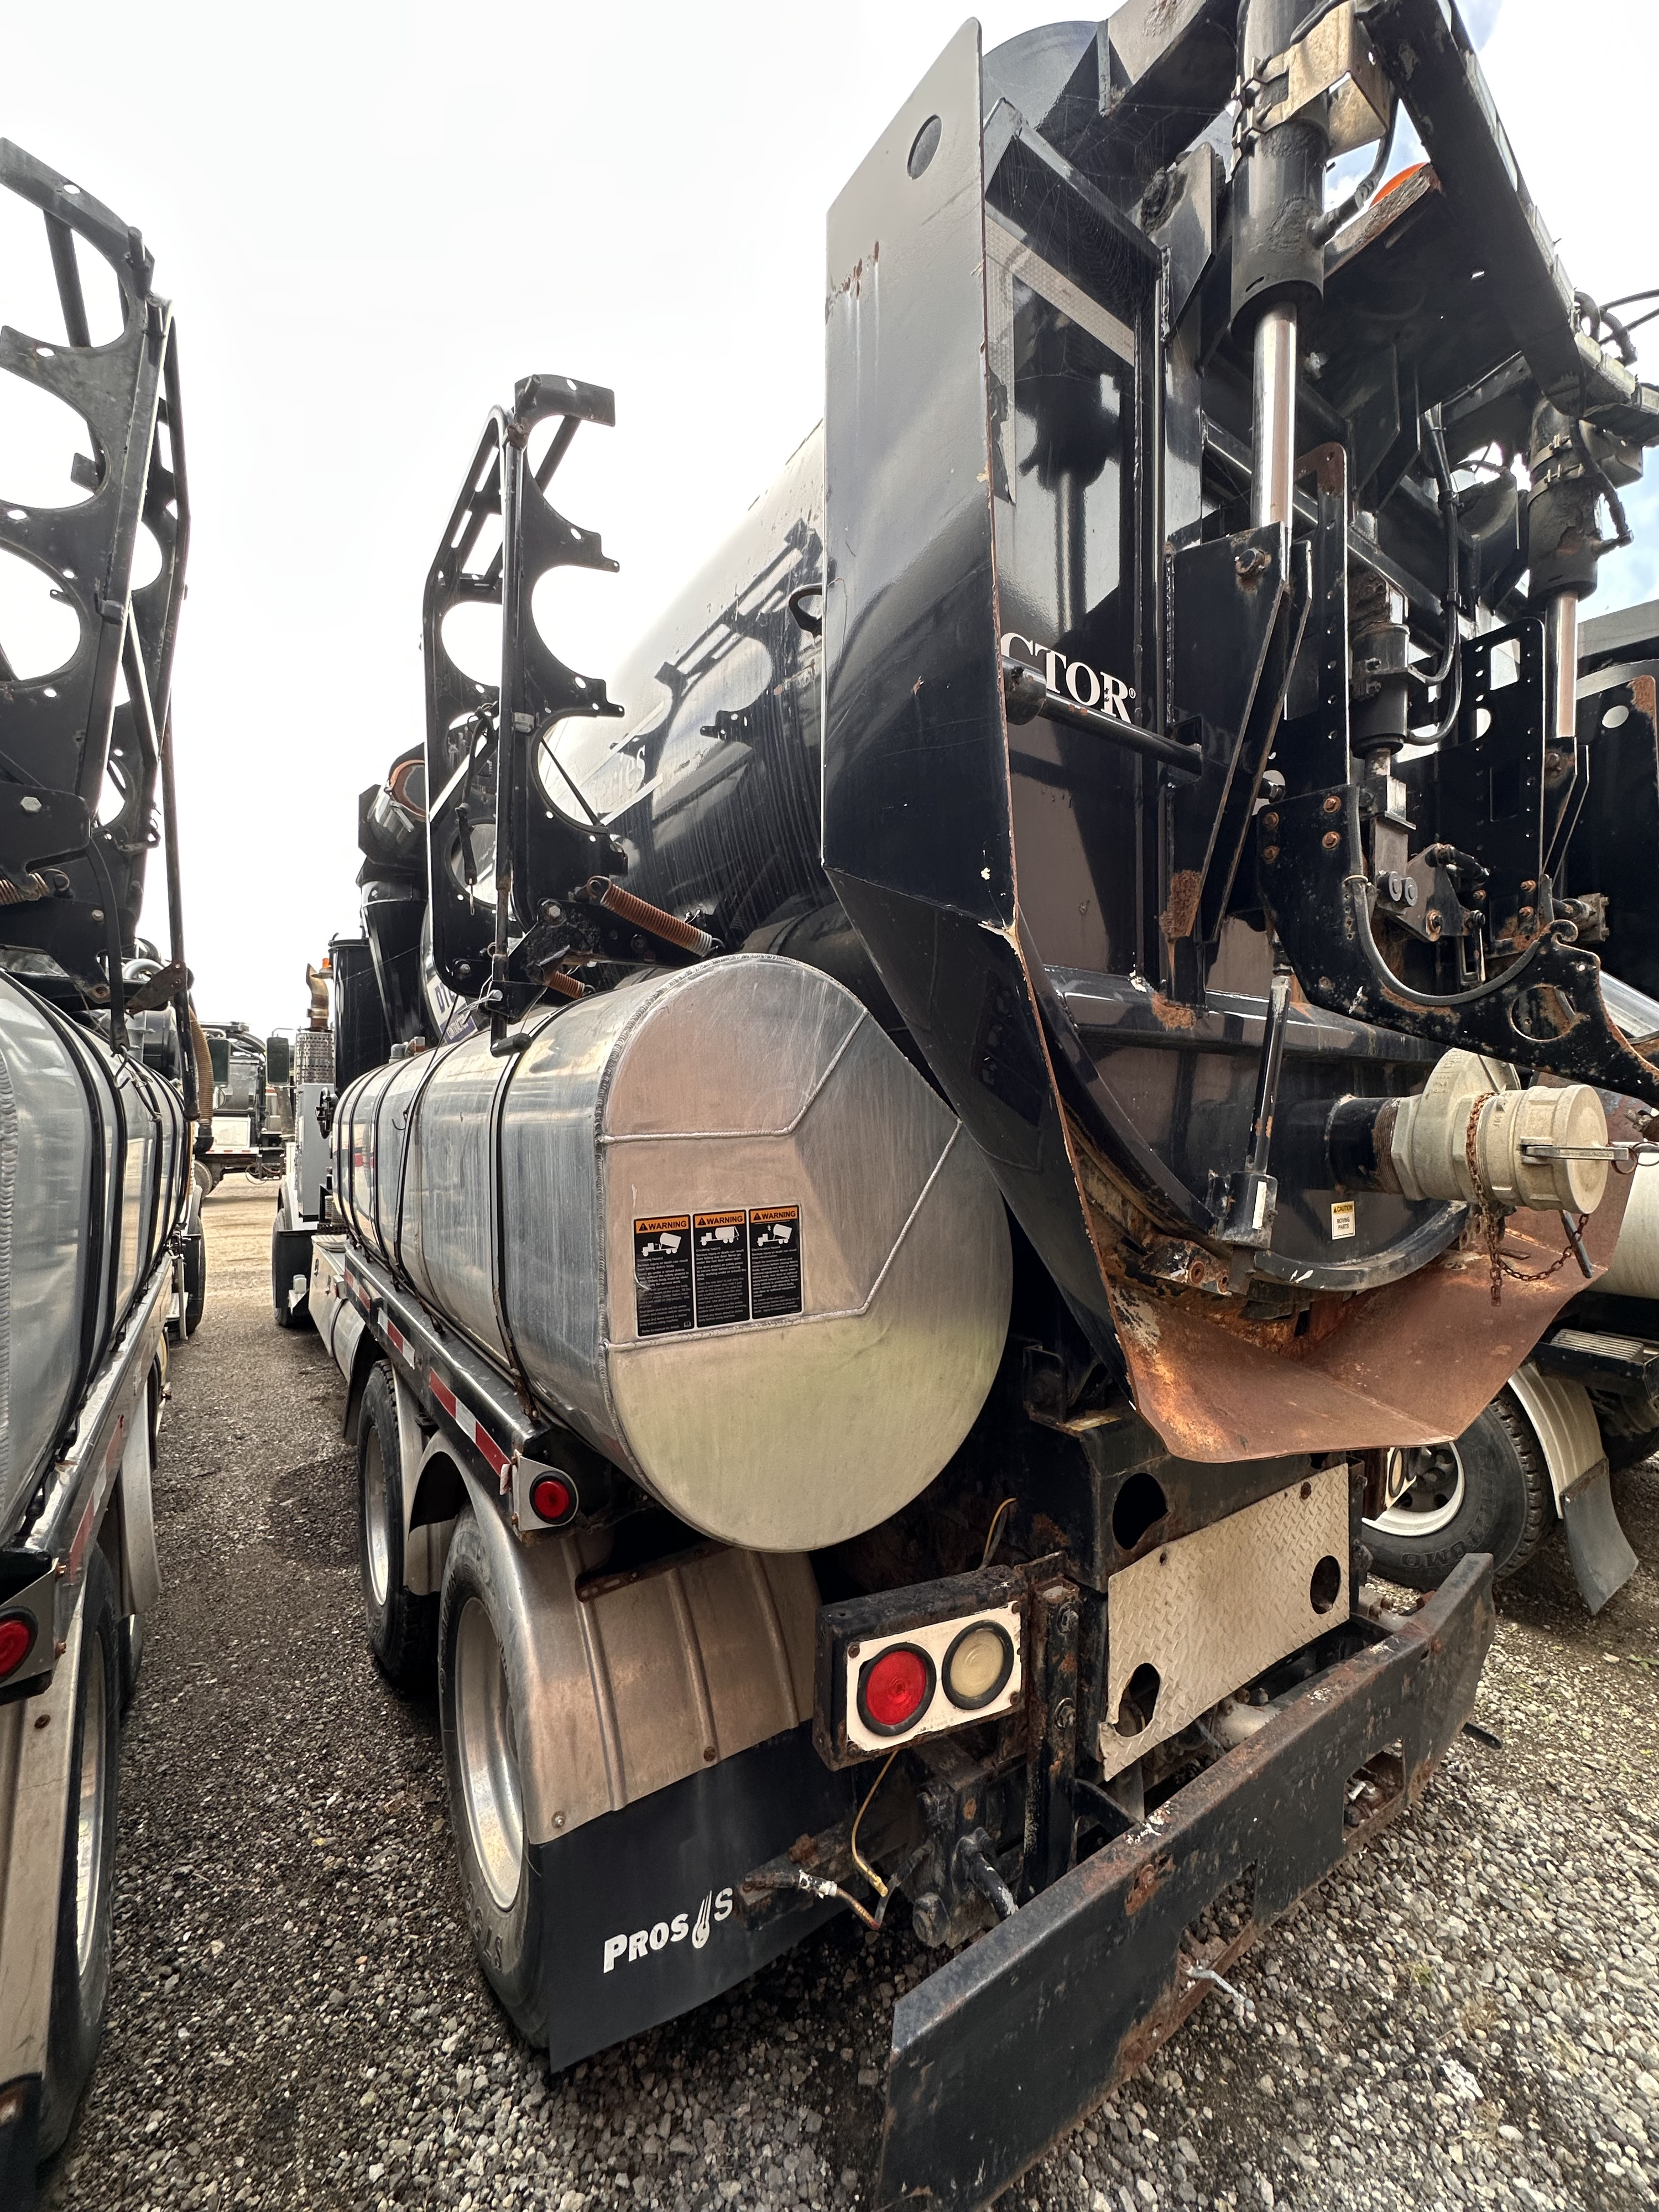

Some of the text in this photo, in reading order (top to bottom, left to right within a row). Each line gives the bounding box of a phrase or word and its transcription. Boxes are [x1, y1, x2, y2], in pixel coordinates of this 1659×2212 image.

[707, 1215, 743, 1225] WARNING
[761, 1211, 796, 1220] WARNING
[648, 1220, 687, 1230] WARNING
[603, 1913, 689, 1974] PROS
